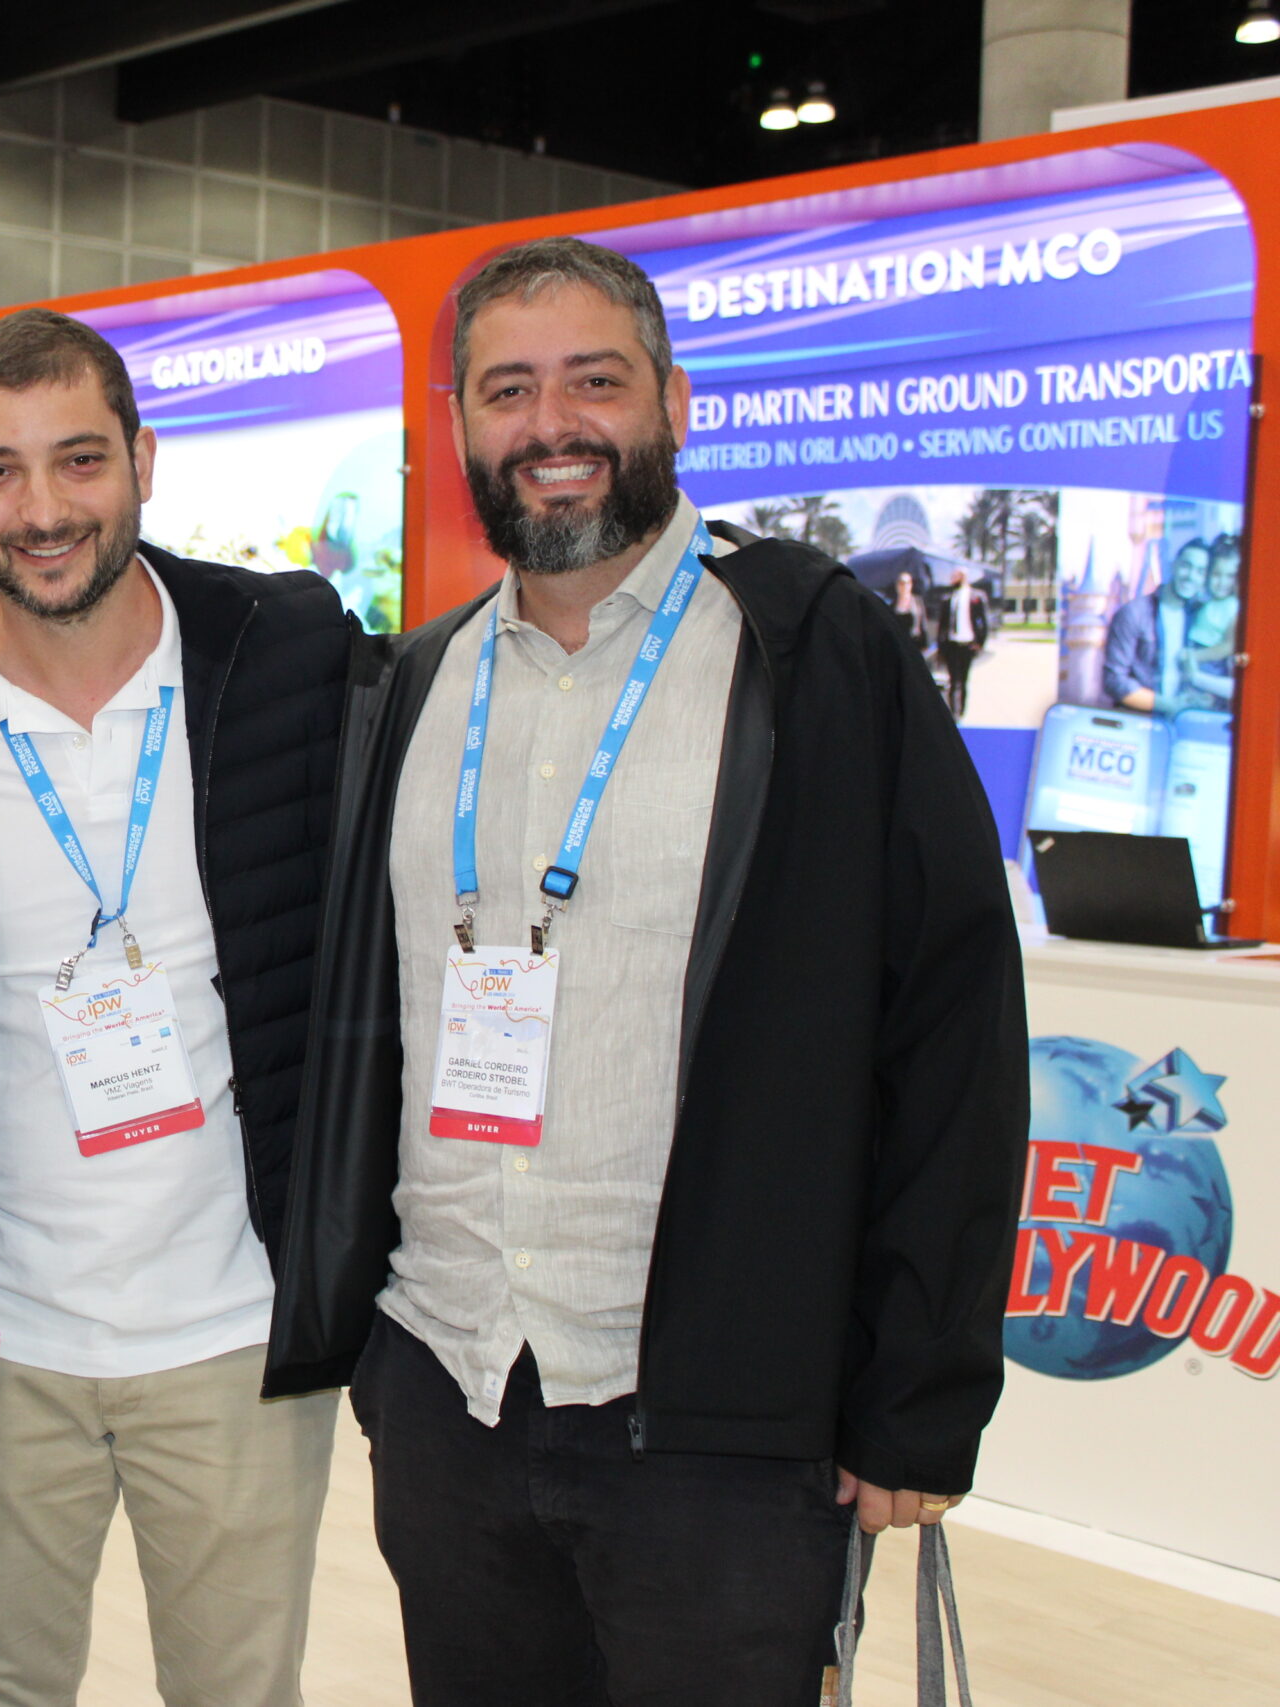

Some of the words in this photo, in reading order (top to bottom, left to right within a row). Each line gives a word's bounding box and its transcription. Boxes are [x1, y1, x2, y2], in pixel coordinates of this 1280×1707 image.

[687, 244, 985, 322] DESTINATION
[998, 227, 1122, 287] MCO
[151, 337, 326, 390] GATORLAND
[688, 394, 727, 431] ED
[732, 384, 853, 428] PARTNER
[860, 380, 889, 418] IN
[896, 369, 1027, 415] GROUND
[1035, 349, 1253, 405] TRANSPORTA
[775, 439, 796, 466] IN
[800, 432, 898, 466] ORLANDO
[918, 425, 1014, 459] SERVING
[1019, 413, 1180, 452] CONTINENTAL
[1187, 408, 1225, 441] US
[660, 570, 688, 616] AMERICAN
[671, 573, 696, 615] EXPRESS
[644, 635, 664, 662] ipw
[473, 659, 485, 706] AMERICAN
[479, 658, 490, 699] EXPRESS
[611, 680, 640, 730] AMERICAN
[620, 682, 646, 726] EXPRESS
[145, 706, 160, 757] AMERICAN
[153, 706, 167, 752] EXPRESS
[470, 726, 481, 751] ipw
[10, 736, 35, 777] EXPRESS
[594, 751, 613, 779] ipw
[1071, 744, 1136, 776] MCO
[39, 793, 58, 817] ipw
[140, 777, 153, 805] ipw
[458, 769, 471, 818] AMERICAN
[465, 768, 477, 812] EXPRESS
[564, 798, 588, 852] AMERICAN
[573, 799, 594, 847] EXPRESS
[63, 842, 90, 882] EXPRESS
[65, 834, 92, 882] AMERICAN
[124, 824, 140, 875] AMERICAN
[129, 825, 144, 871] EXPRESS
[480, 976, 512, 996] ipw
[87, 995, 122, 1020] ipw
[104, 1020, 125, 1030] World
[448, 1022, 466, 1033] ipw
[66, 1053, 87, 1066] ipw
[90, 1072, 130, 1089] MARCUS
[131, 1063, 161, 1079] HENTZ
[446, 1068, 487, 1081] CORDEIRO
[489, 1073, 528, 1086] STROBEL
[448, 1057, 482, 1069] GABRIEL
[484, 1061, 528, 1074] CORDEIRO
[104, 1085, 121, 1095] VMZ
[123, 1077, 153, 1090] Viagens
[441, 1079, 456, 1087] BWT
[458, 1081, 492, 1093] Operadora
[493, 1086, 502, 1094] de
[503, 1087, 530, 1097] Turismo
[124, 1124, 160, 1140] BUYER
[468, 1124, 499, 1133] BUYER
[1004, 1228, 1280, 1382] LYWOOD
